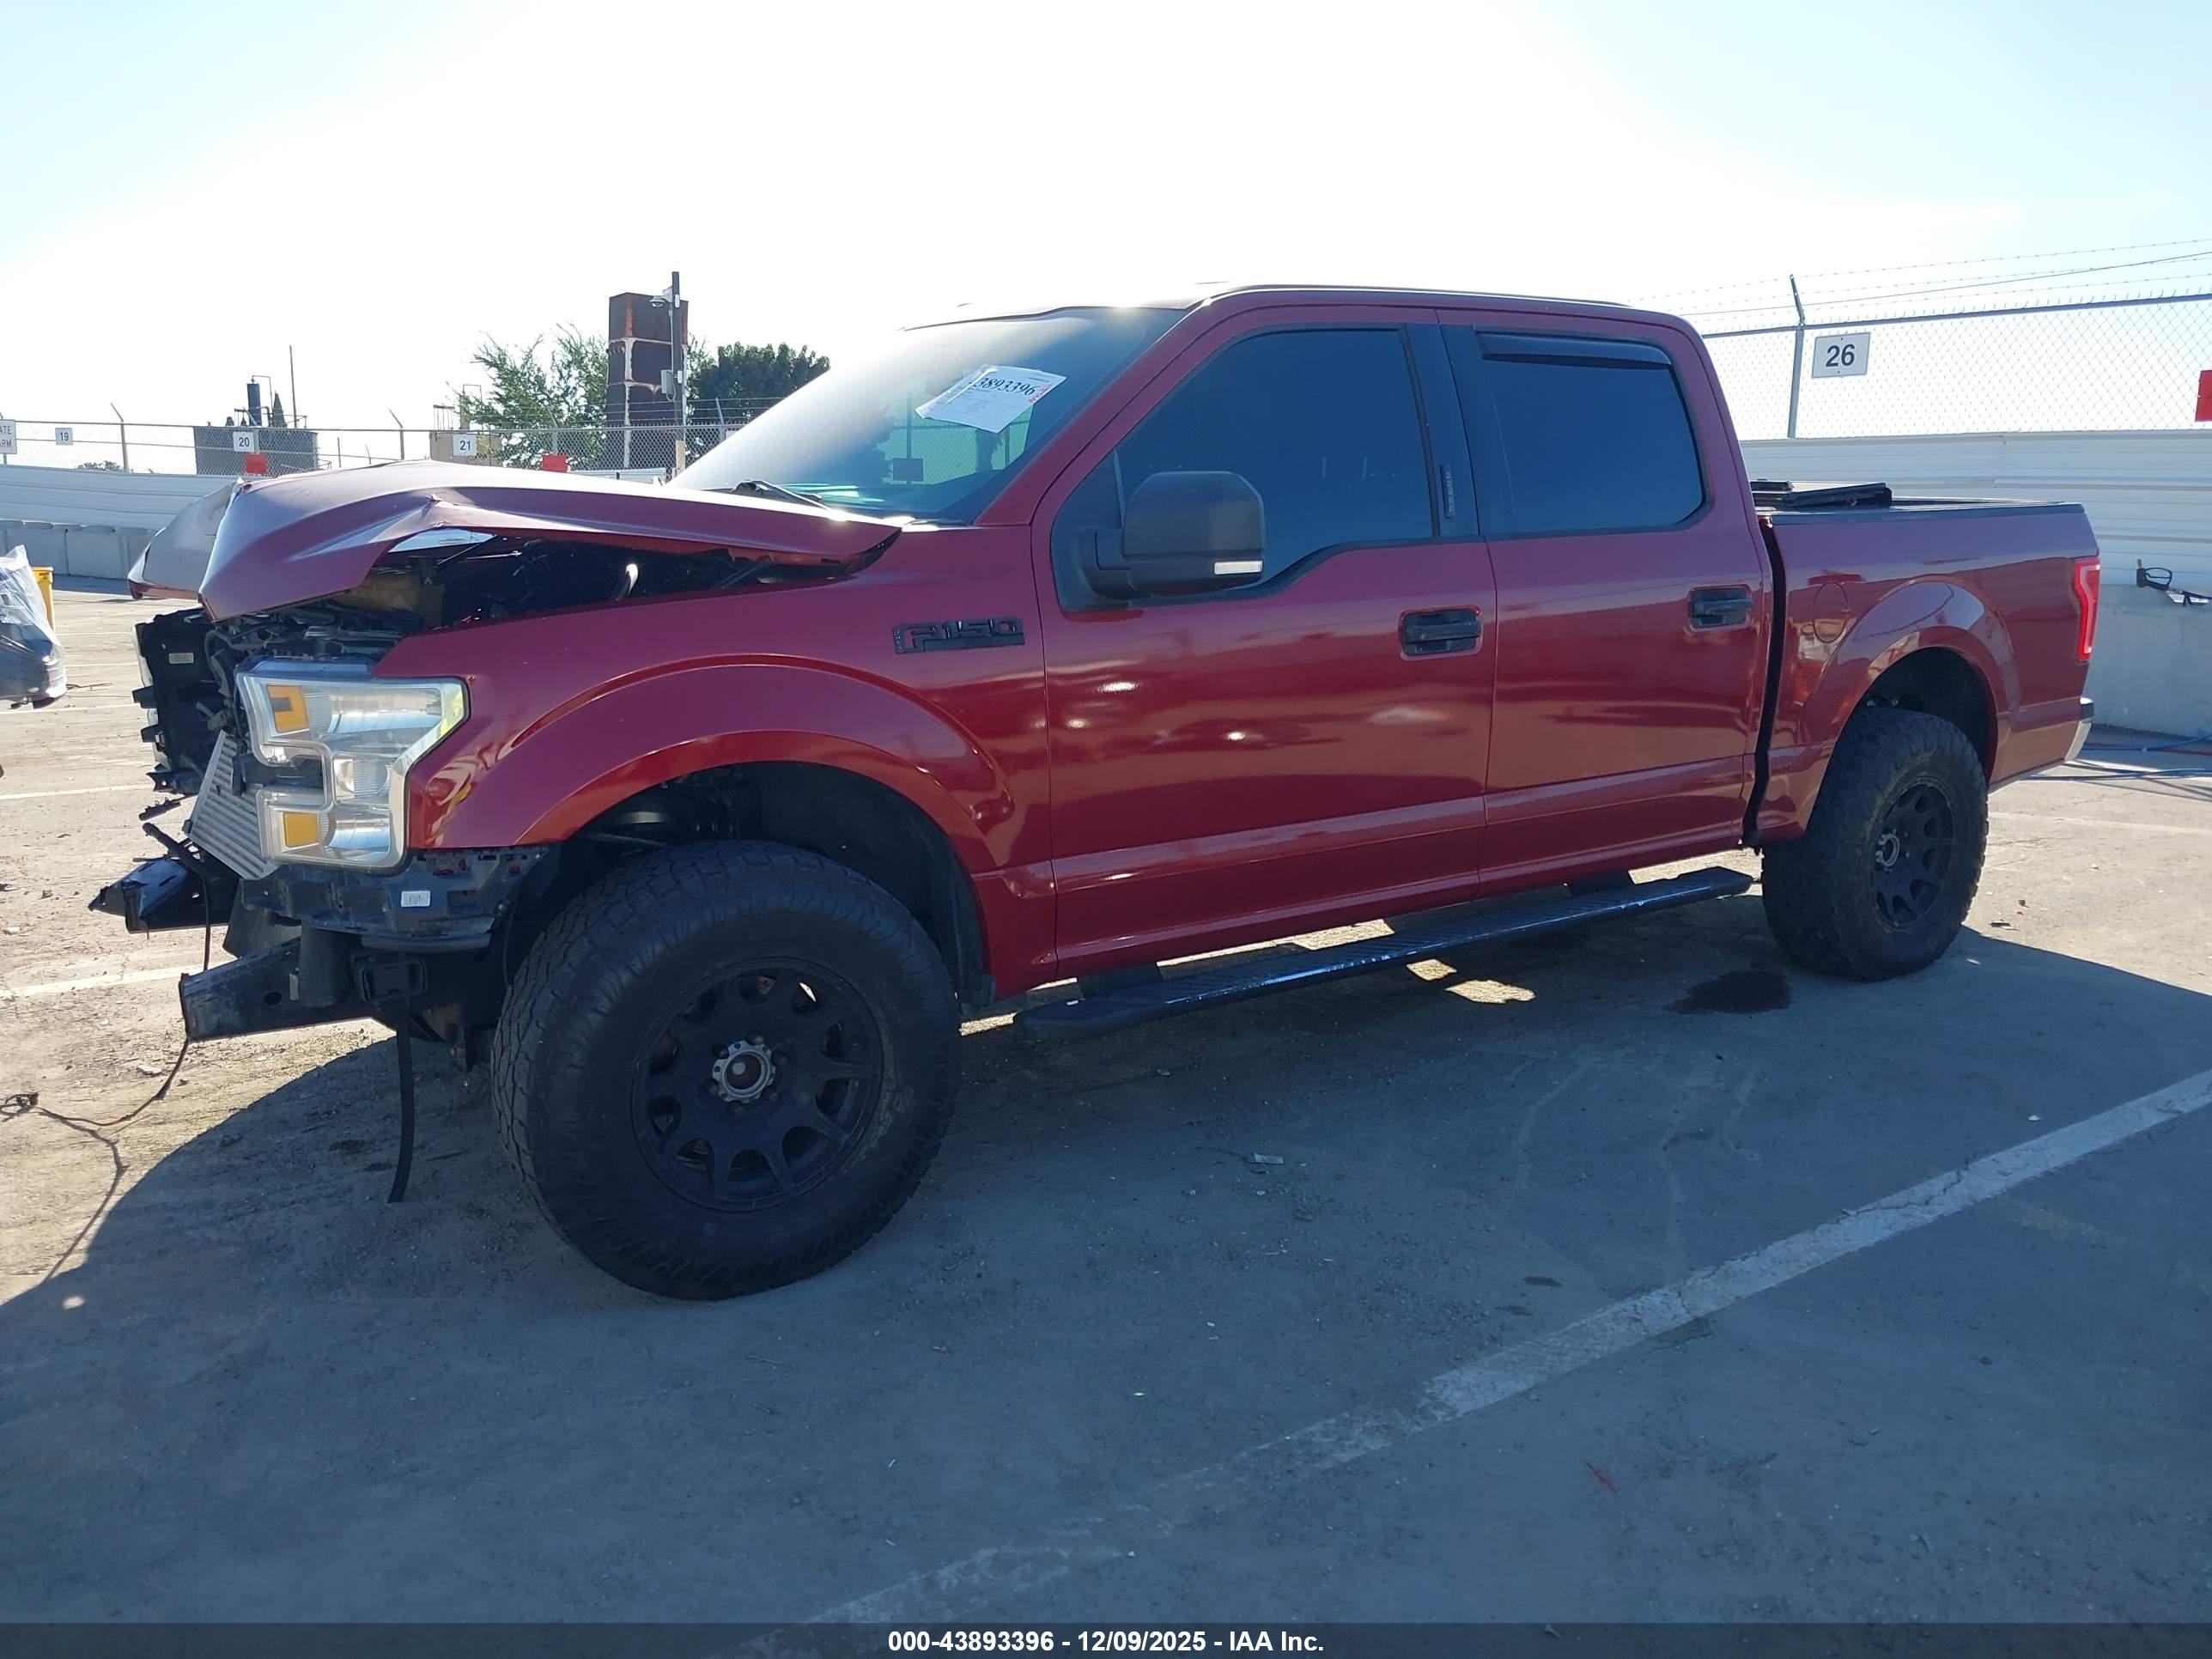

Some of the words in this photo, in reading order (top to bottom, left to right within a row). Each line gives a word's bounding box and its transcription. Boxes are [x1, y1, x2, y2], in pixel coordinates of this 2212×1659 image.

[1826, 343, 1856, 368] 26
[969, 376, 1036, 396] 3893396
[59, 432, 70, 441] 19
[239, 436, 250, 447] 20
[459, 440, 471, 451] 21
